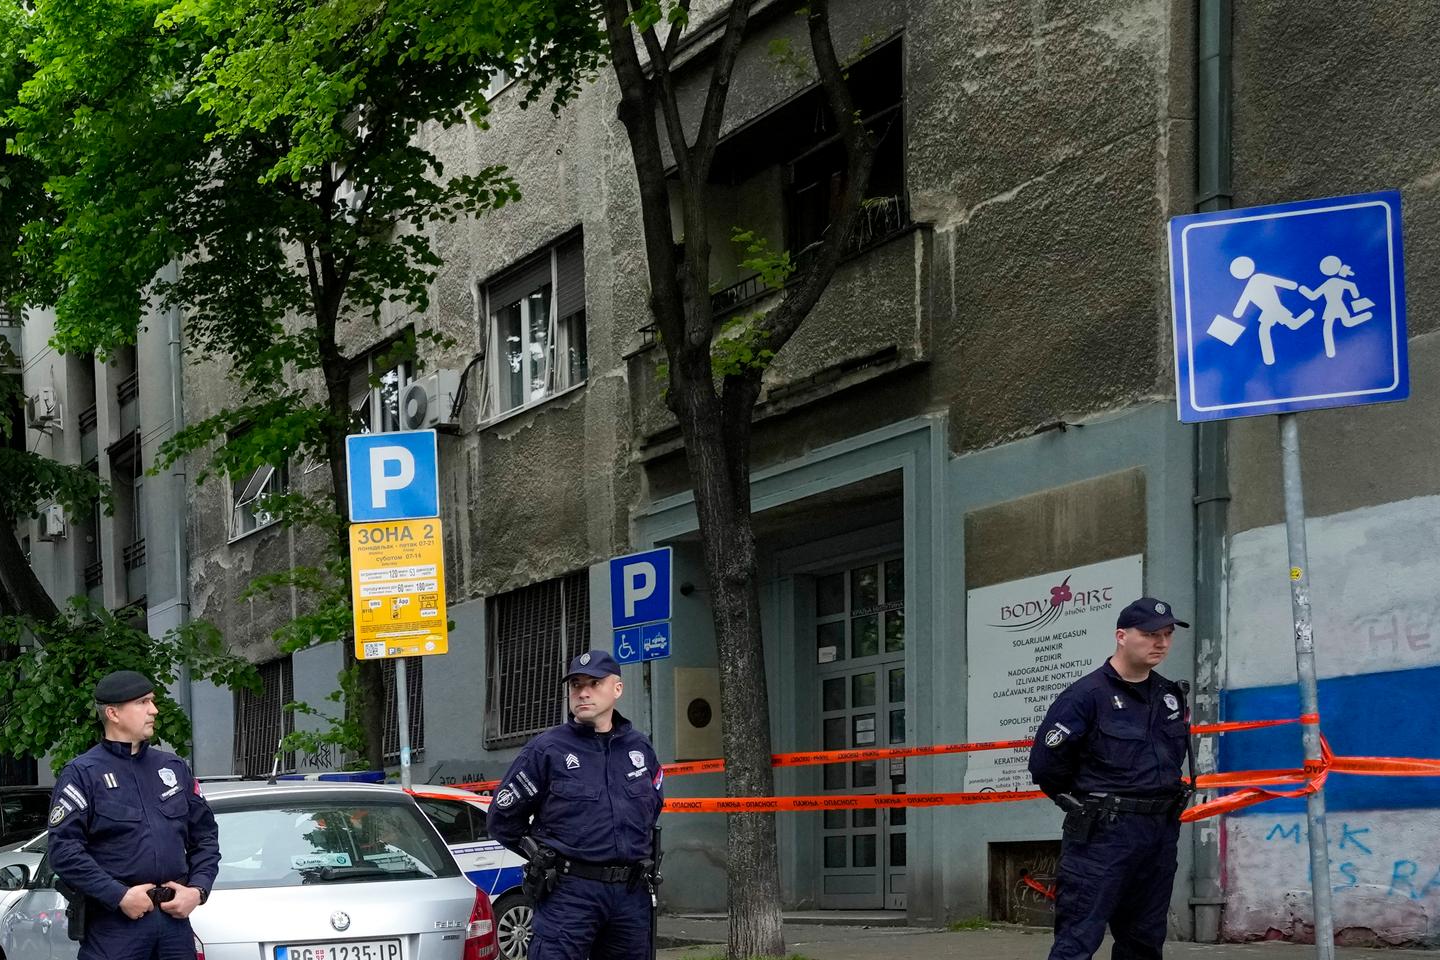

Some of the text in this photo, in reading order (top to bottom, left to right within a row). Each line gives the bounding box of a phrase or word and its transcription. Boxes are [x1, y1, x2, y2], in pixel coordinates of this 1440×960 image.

[370, 446, 415, 508] P
[358, 524, 434, 544] ЗОНА 2
[623, 562, 656, 618] P
[1000, 586, 1113, 621] BODY ART
[1065, 603, 1112, 617] studio lepote
[1012, 629, 1087, 648] SOLARIJUM MEGASUN
[1034, 643, 1063, 653] MANIKIR
[1035, 653, 1062, 664] PEDIKIR
[1007, 659, 1092, 678] NADOGRADNJA NOKTIJU
[1015, 670, 1083, 686] IZLIVANJE NOKTIJU
[1024, 695, 1048, 704] TRAJNI
[1034, 705, 1046, 713] GEL
[994, 756, 1028, 765] KERATINSK
[1266, 823, 1372, 854] MK
[434, 920, 461, 928] Fabia
